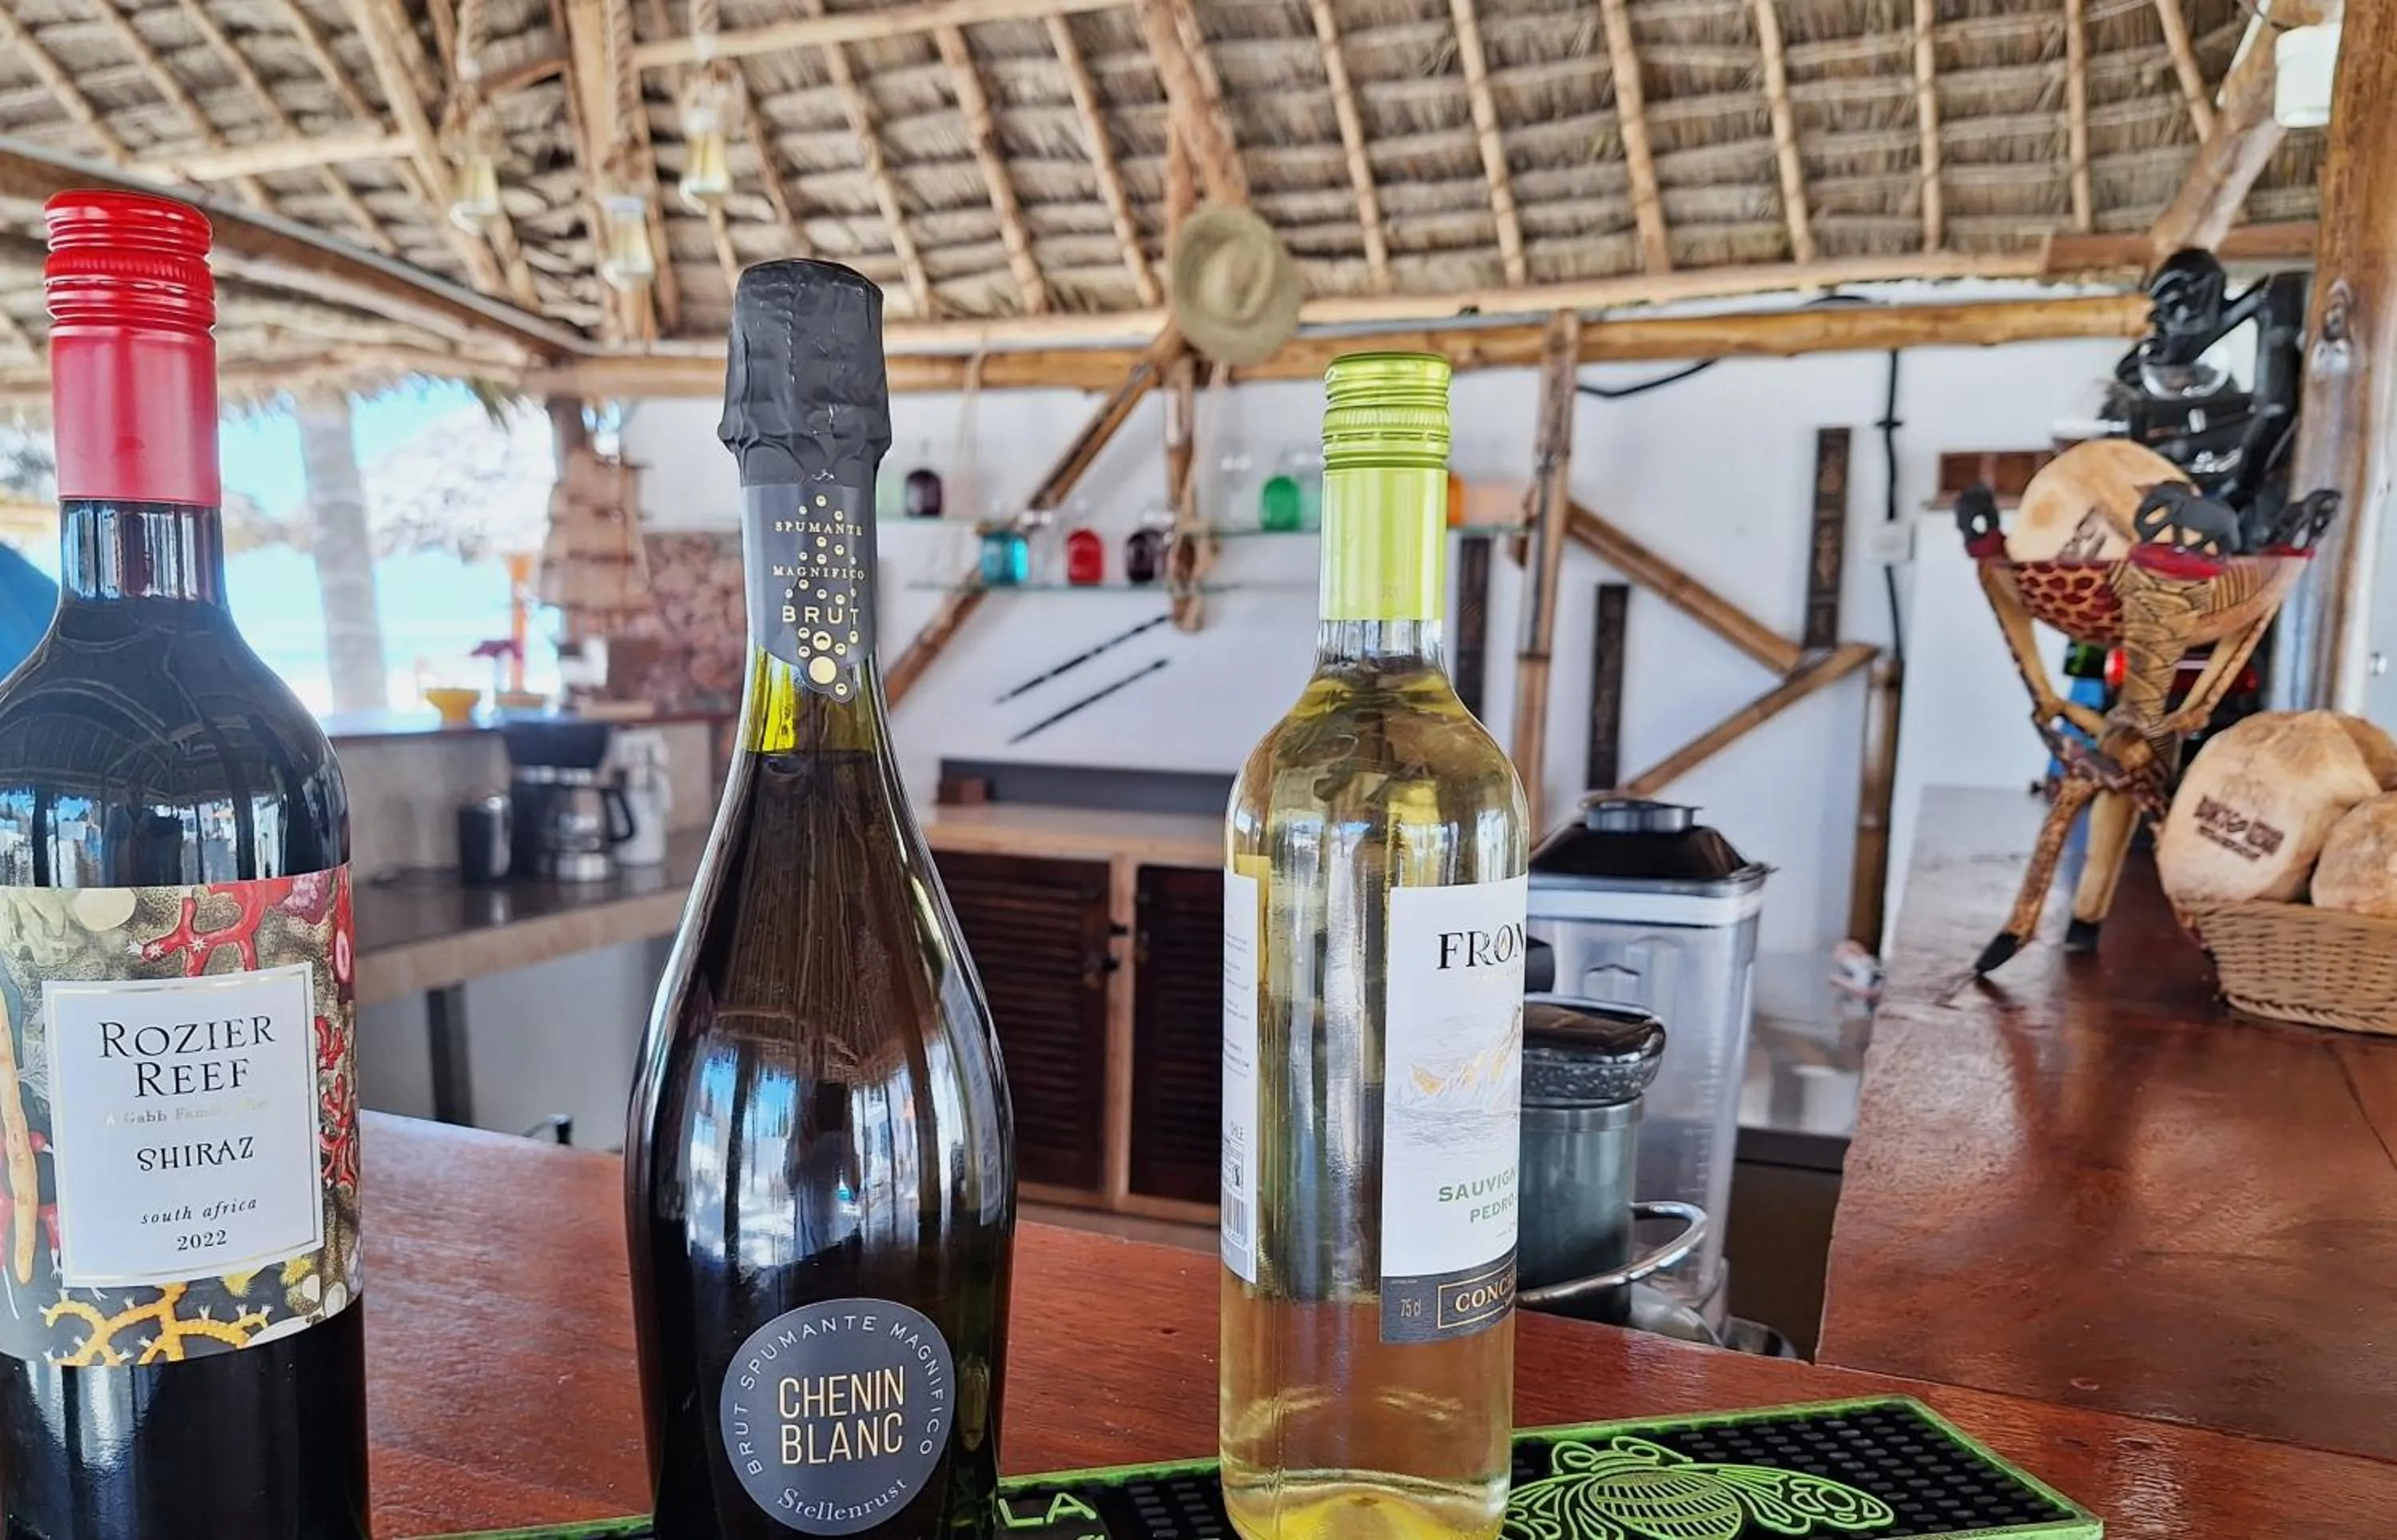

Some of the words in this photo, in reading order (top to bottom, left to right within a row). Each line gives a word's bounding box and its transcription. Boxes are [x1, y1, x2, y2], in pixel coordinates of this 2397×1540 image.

[775, 521, 862, 536] SPUMANTE
[773, 565, 865, 581] MAGNIFICO
[782, 605, 859, 625] BRUT
[98, 1015, 276, 1058] ROZIER
[134, 1058, 251, 1097] REEF
[137, 1136, 254, 1172] SHIRAZ
[140, 1205, 192, 1224] south
[202, 1198, 256, 1220] africa
[177, 1229, 227, 1251] 2022
[1400, 1299, 1412, 1317] 75
[741, 1316, 878, 1391] SPUMANTE
[778, 1365, 904, 1419] CHENIN
[890, 1321, 944, 1455] MAGNIFICO
[734, 1403, 763, 1476] BRUT
[781, 1411, 903, 1465] BLANC
[777, 1478, 908, 1521] Stellenrust
